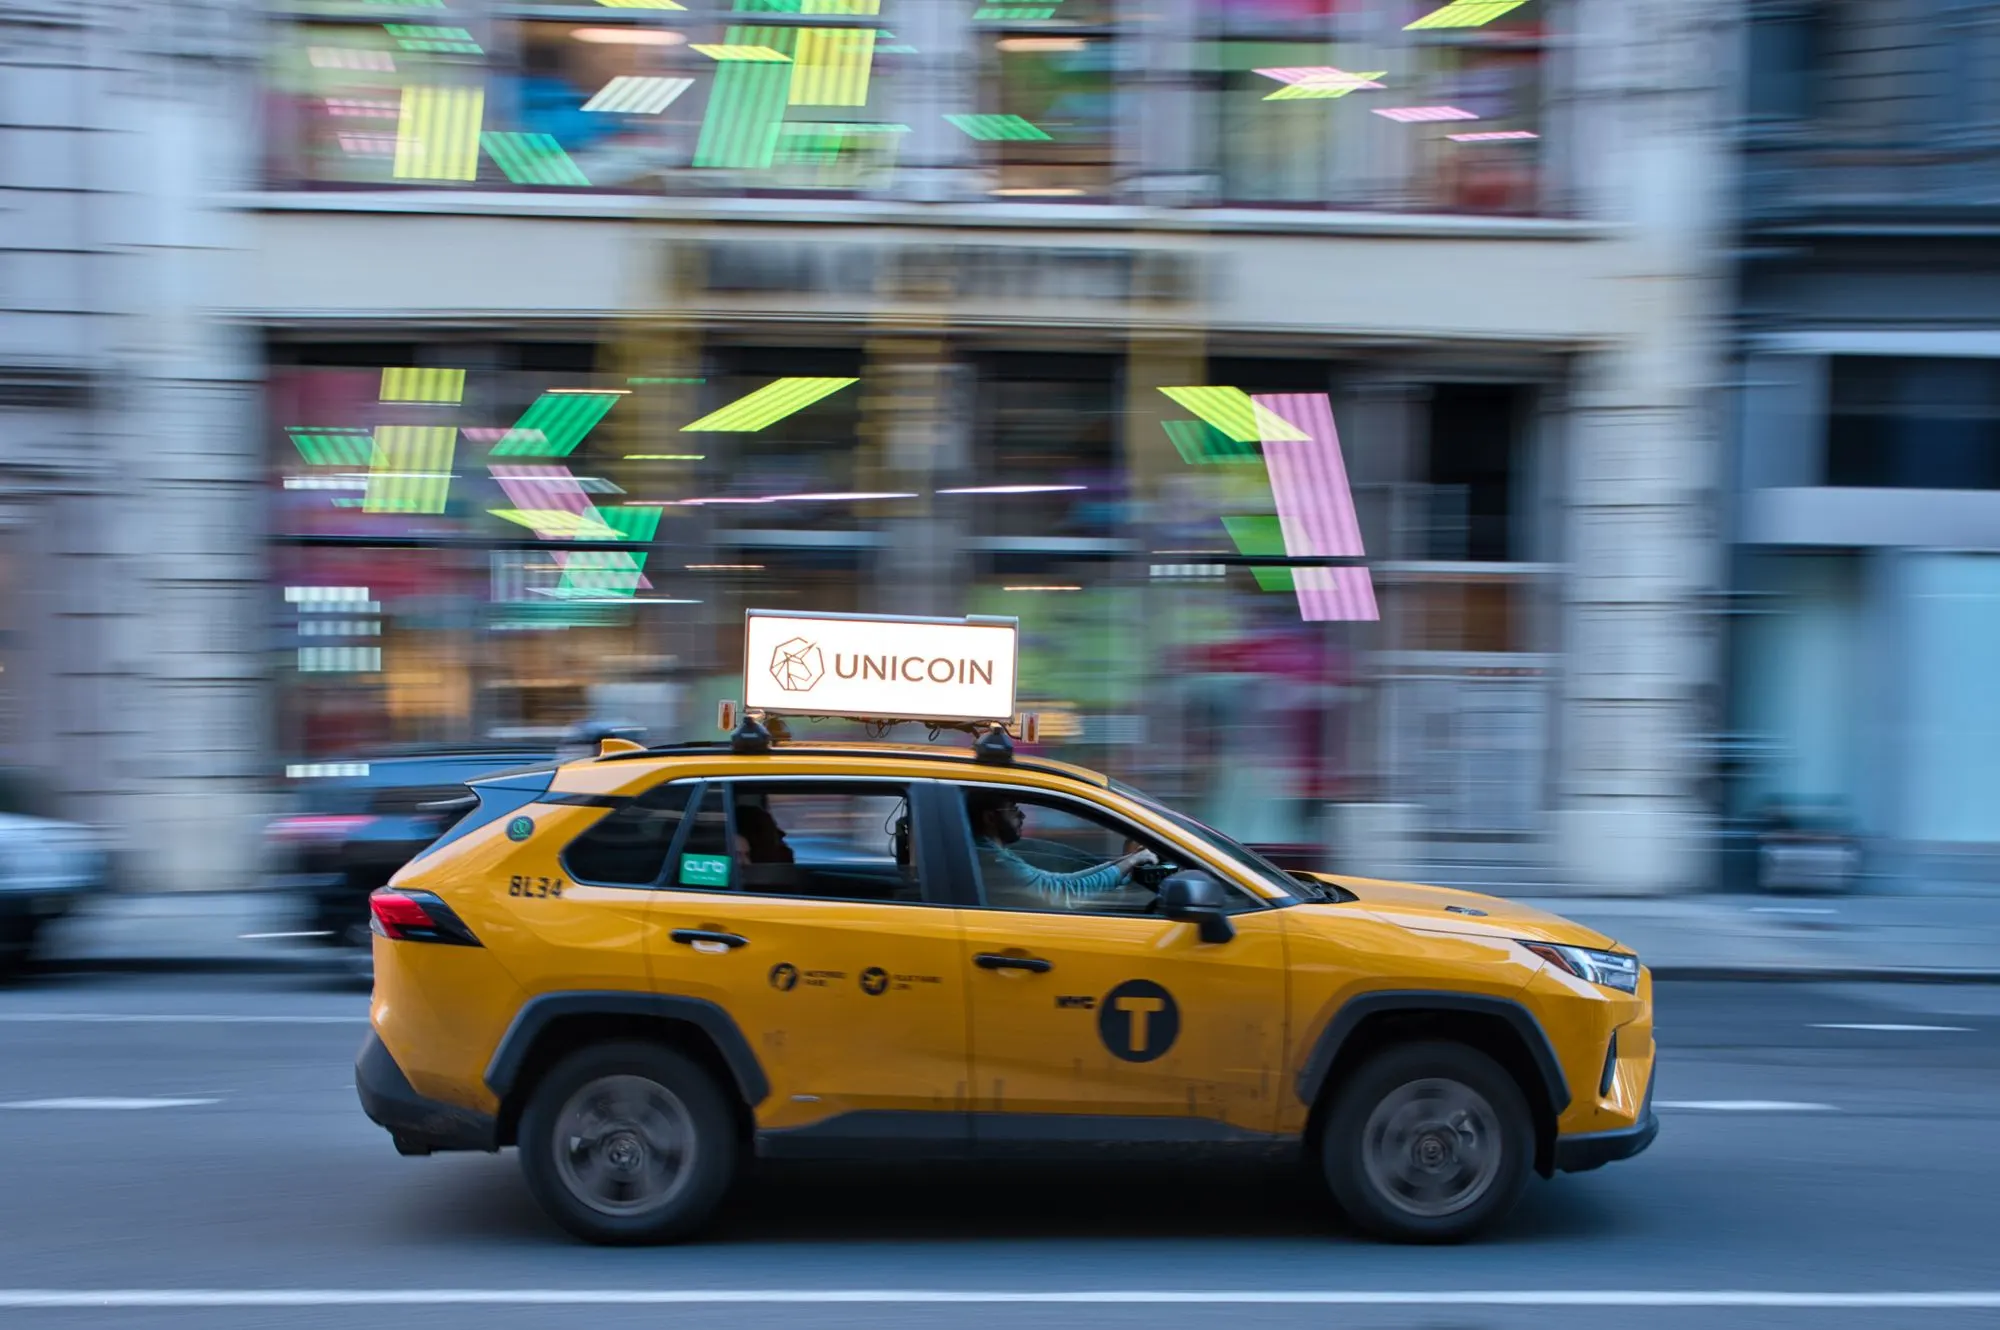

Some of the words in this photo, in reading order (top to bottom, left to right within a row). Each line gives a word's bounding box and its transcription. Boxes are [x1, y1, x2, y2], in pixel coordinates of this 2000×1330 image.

[835, 653, 993, 685] UNICOIN
[684, 860, 727, 873] curb
[509, 875, 562, 899] BL34
[1115, 997, 1164, 1051] T
